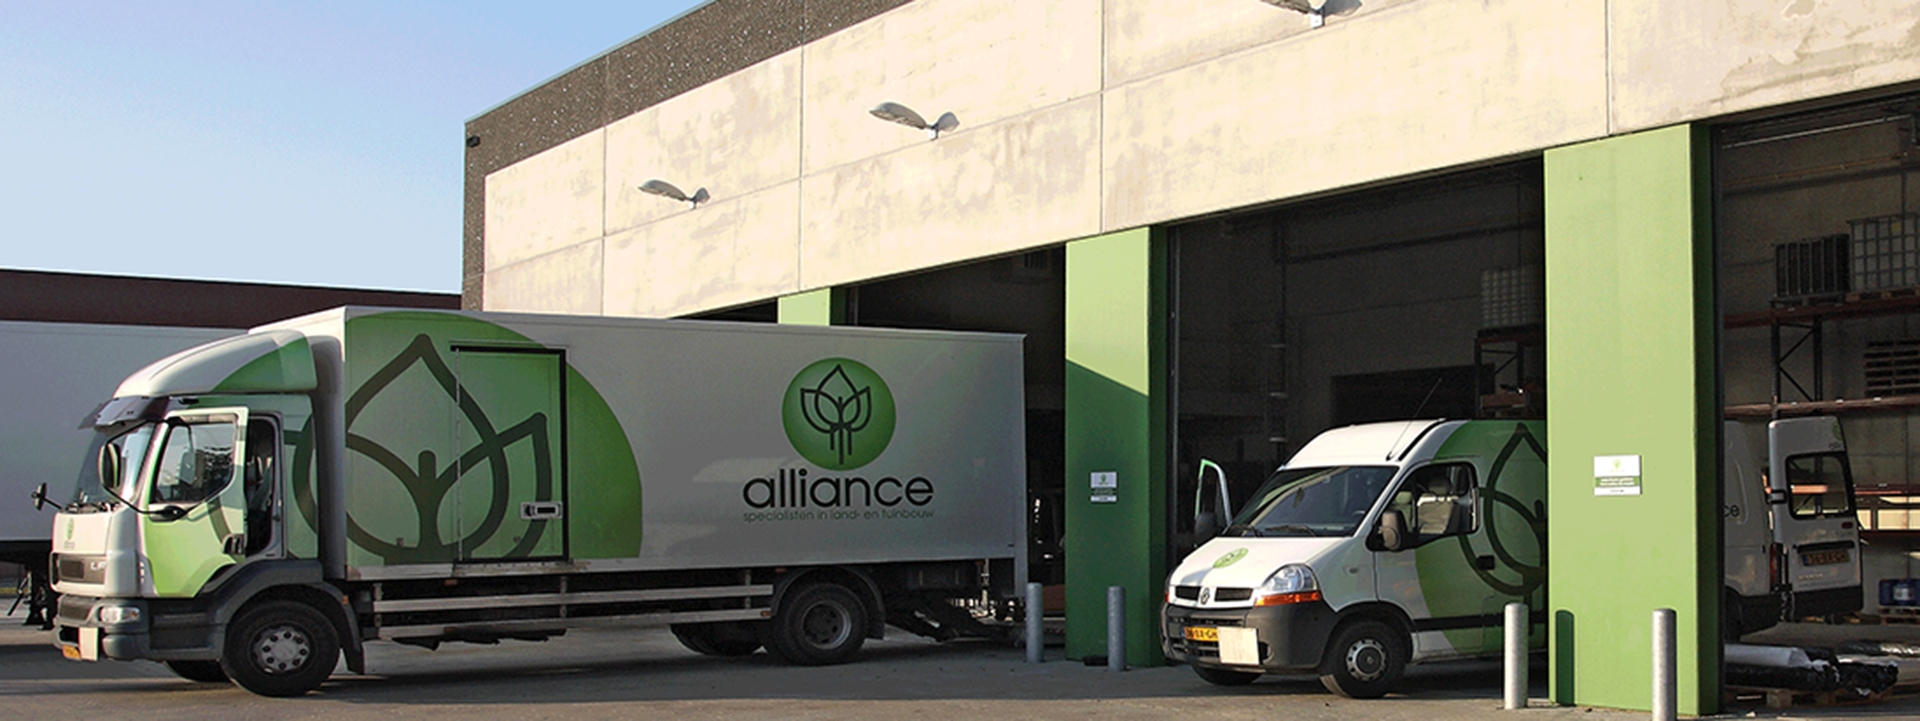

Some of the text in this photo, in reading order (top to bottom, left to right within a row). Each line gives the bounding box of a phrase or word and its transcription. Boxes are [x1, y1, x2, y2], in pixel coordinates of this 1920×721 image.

[743, 468, 933, 508] alliance
[743, 507, 934, 524] specialisten in land- en tuinbouw
